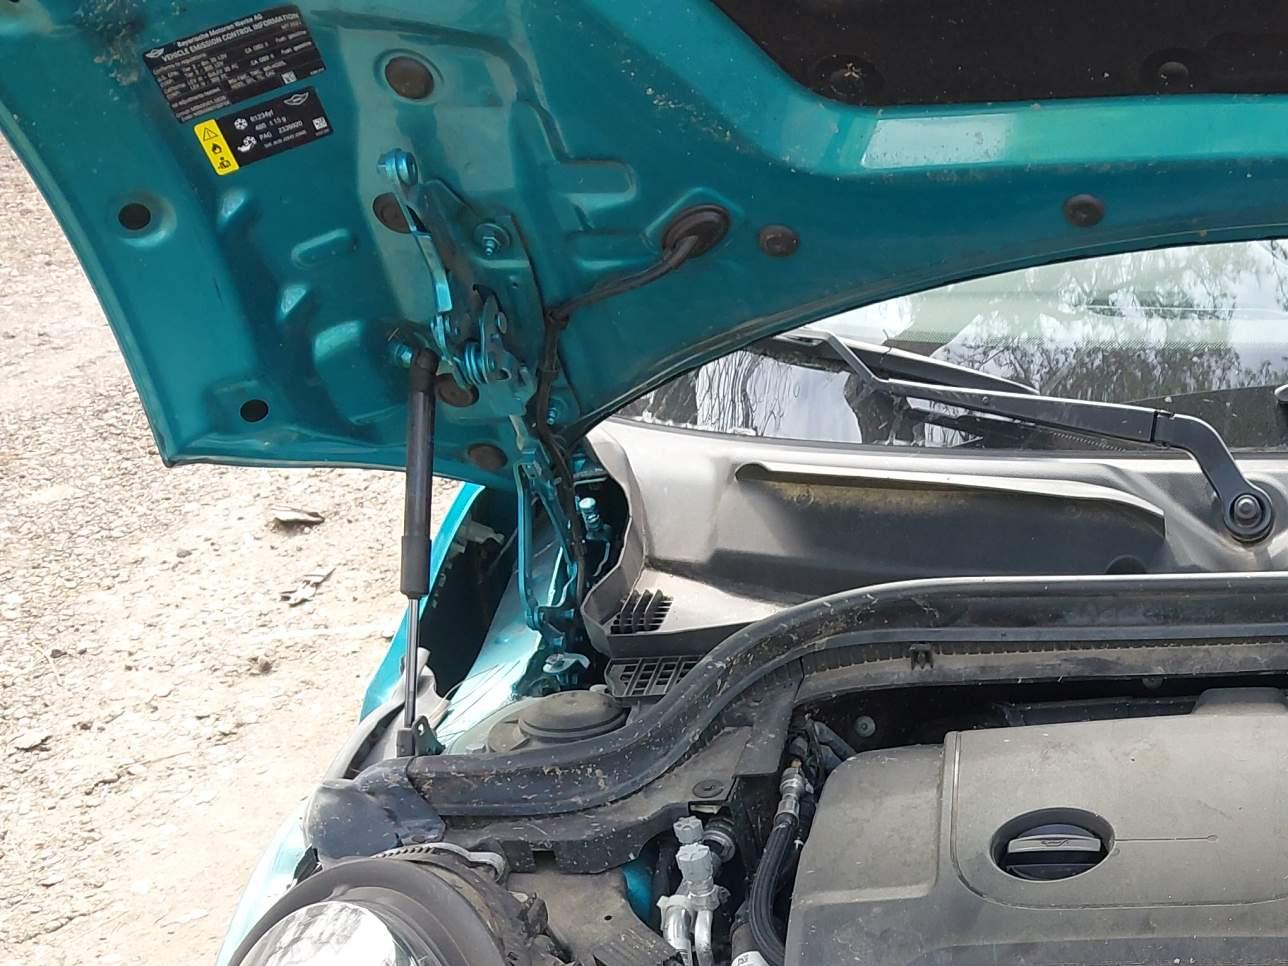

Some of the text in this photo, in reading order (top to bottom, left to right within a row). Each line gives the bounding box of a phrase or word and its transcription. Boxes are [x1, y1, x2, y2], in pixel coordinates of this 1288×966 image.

[189, 35, 223, 53] EMISSION
[222, 27, 253, 42] CONTROL
[253, 13, 299, 31] INFORMATION
